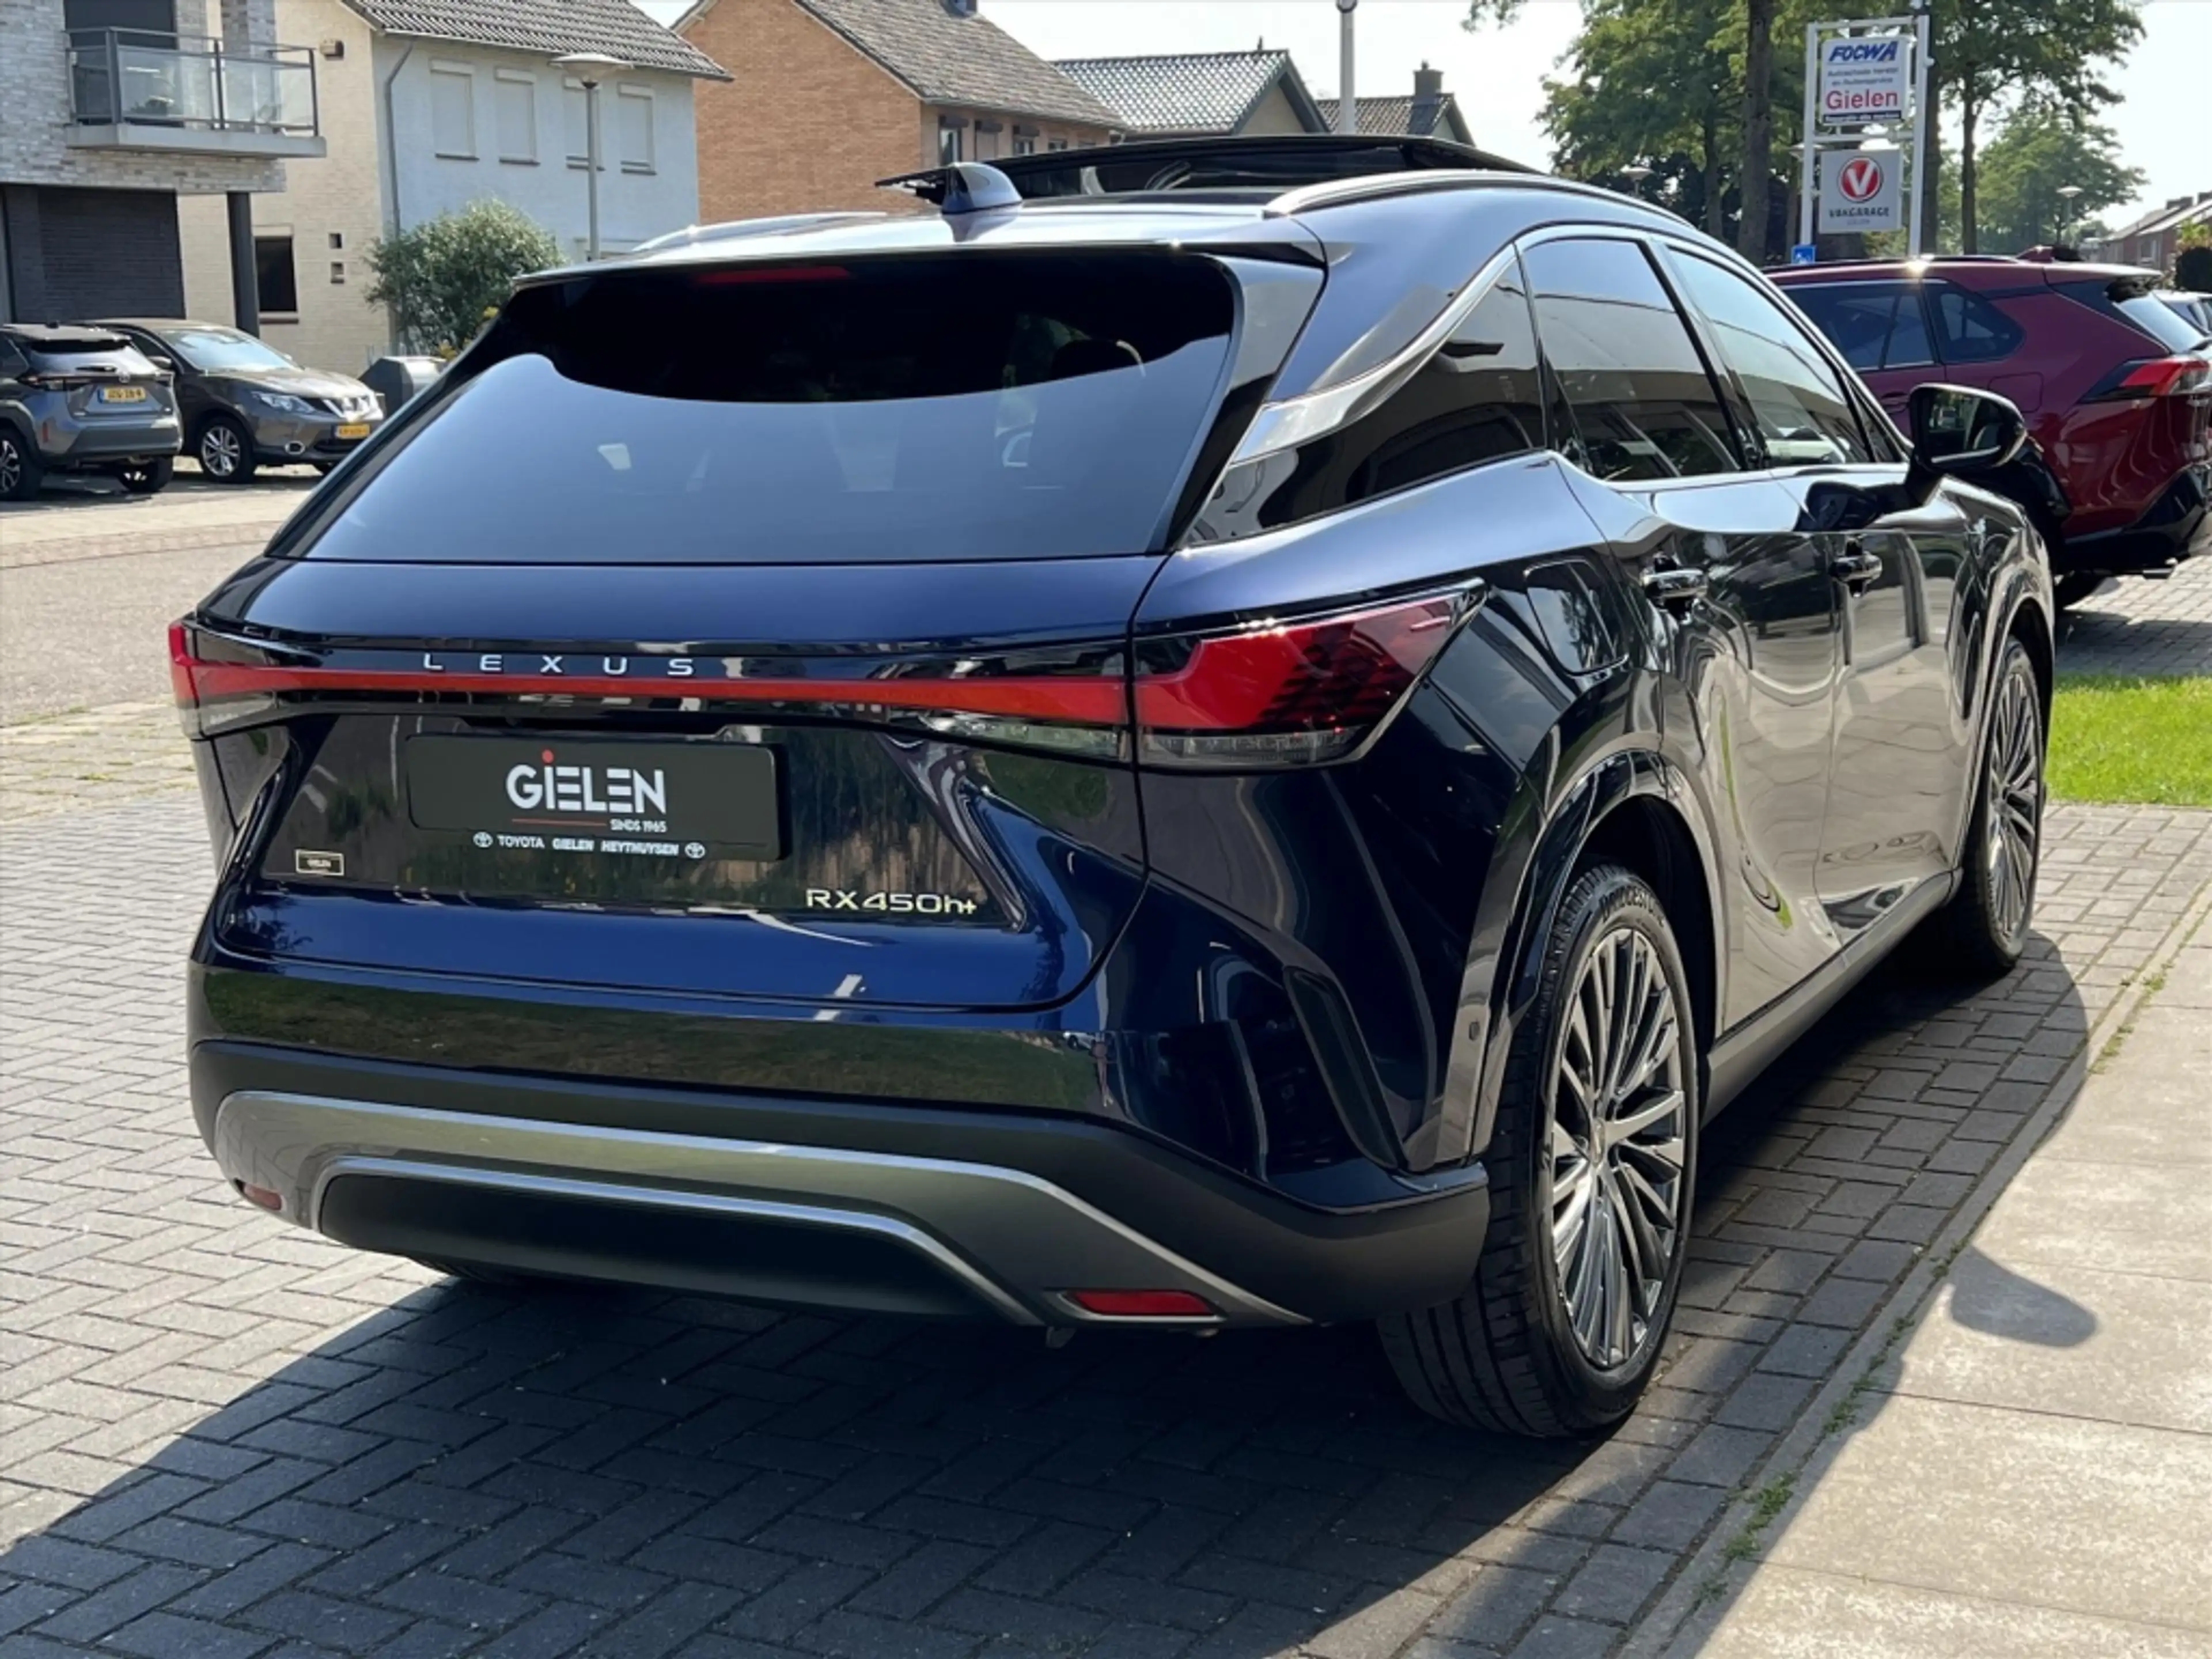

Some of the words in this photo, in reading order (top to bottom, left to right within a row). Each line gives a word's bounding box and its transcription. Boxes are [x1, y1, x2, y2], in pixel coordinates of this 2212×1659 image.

[1828, 41, 1898, 61] FOCWA
[1827, 89, 1897, 109] Gielen
[423, 653, 694, 676] LEXUS
[506, 749, 666, 815] GIELEN
[610, 819, 641, 831] SINDS
[642, 820, 666, 833] 1965
[497, 835, 544, 849] TOYOTA
[552, 838, 594, 851] GIELEN
